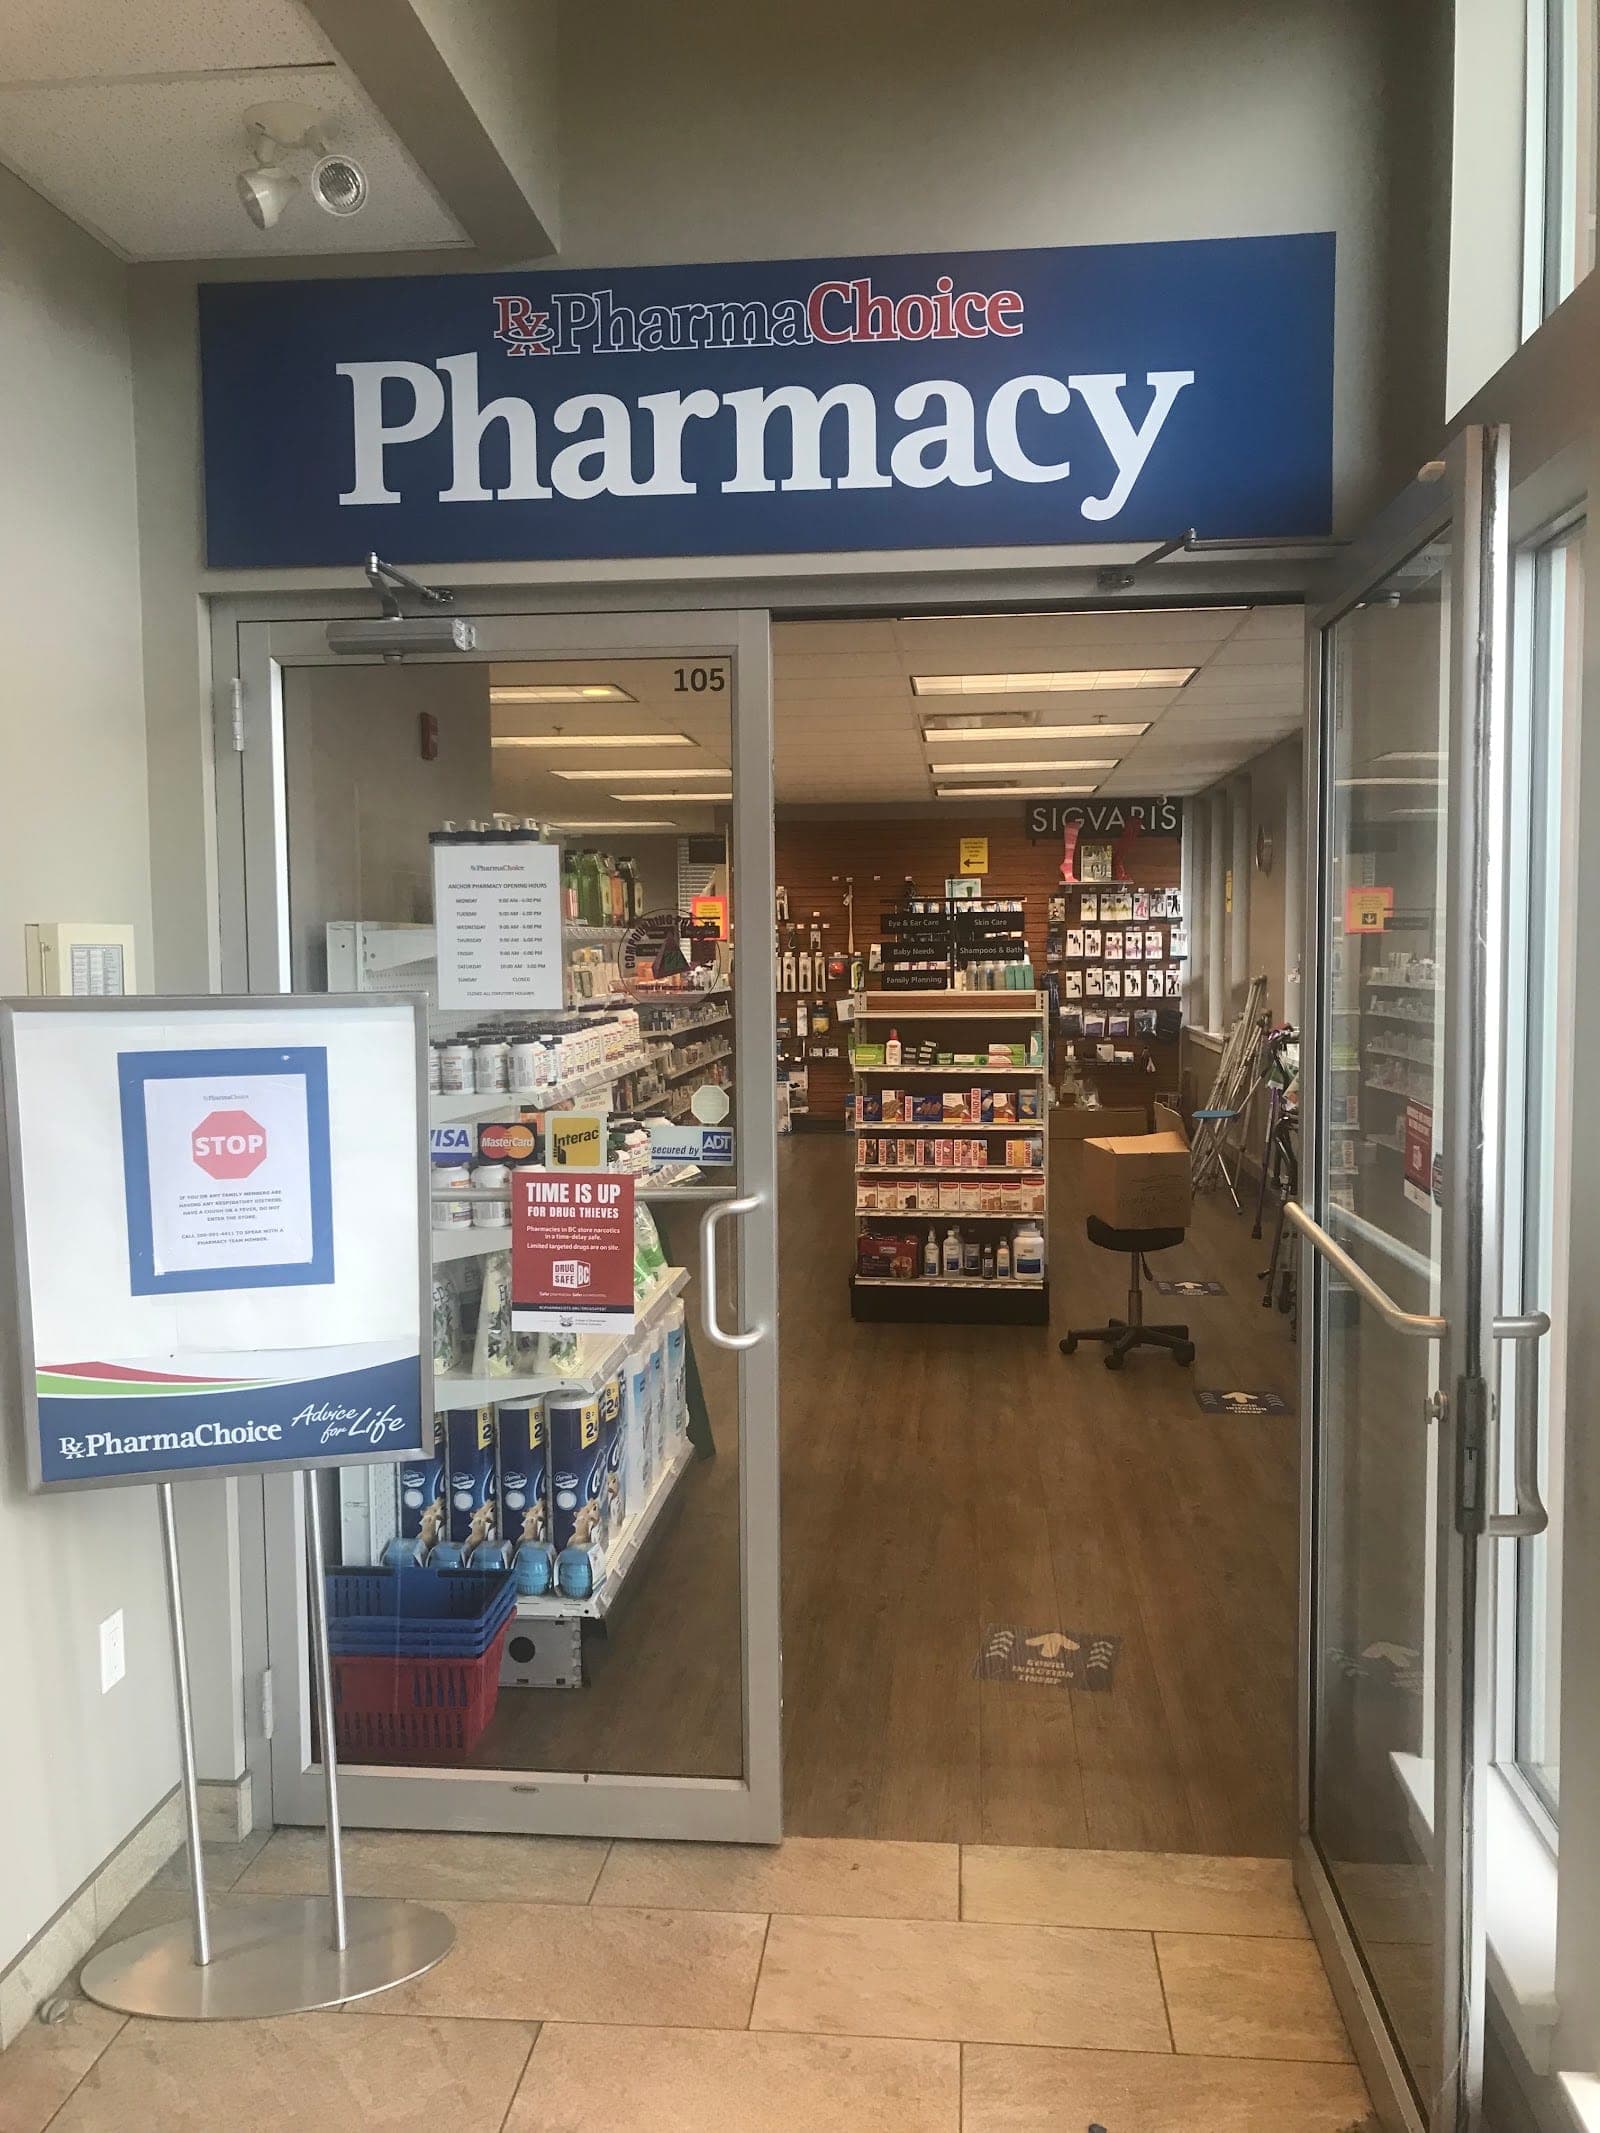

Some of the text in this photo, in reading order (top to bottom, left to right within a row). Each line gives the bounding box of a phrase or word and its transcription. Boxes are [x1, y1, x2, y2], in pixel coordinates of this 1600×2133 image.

[336, 352, 1195, 522] Pharmacy
[674, 668, 725, 692] 105
[1031, 804, 1177, 832] SIGVARIS
[893, 948, 911, 956] Baby
[911, 976, 942, 984] Planning
[194, 1134, 264, 1156] STOP
[481, 1136, 534, 1148] MasterCard
[553, 1129, 599, 1148] Interac
[652, 1136, 732, 1157] secured by ADT
[526, 1182, 621, 1204] TIME IS UP
[528, 1206, 619, 1218] FOR DRUG THIEVES
[554, 1264, 590, 1285] DRUG BC
[554, 1276, 574, 1284] SAFE
[291, 1402, 406, 1444] Advice for Life
